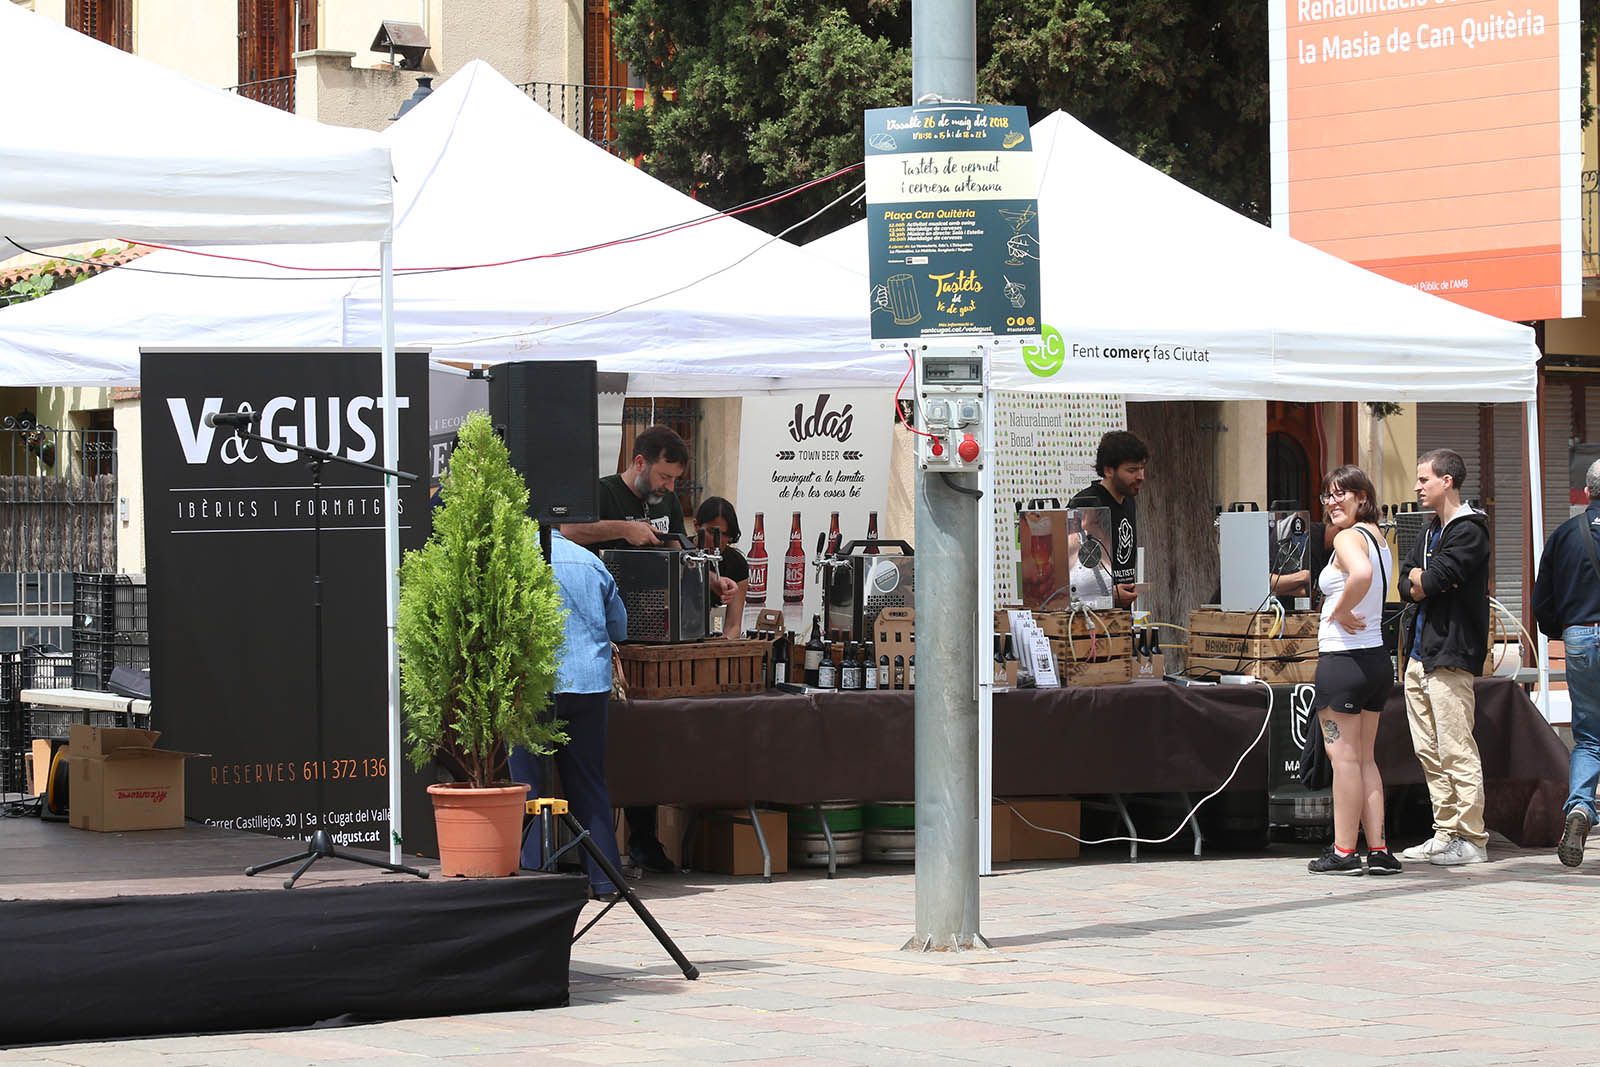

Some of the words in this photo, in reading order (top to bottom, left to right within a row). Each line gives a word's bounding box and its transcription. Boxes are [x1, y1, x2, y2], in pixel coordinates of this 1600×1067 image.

[1298, 39, 1316, 65] la
[1322, 30, 1380, 62] Masia
[1386, 26, 1411, 53] de
[1417, 23, 1454, 49] Can
[1461, 8, 1545, 48] Quitèria
[923, 115, 936, 128] 26
[937, 113, 950, 127] de
[951, 116, 972, 130] maig
[973, 113, 988, 127] del
[989, 116, 1009, 128] 2018
[901, 157, 938, 175] Tastets
[943, 156, 957, 174] de
[961, 155, 1001, 173] vermut
[901, 181, 905, 193] i
[908, 182, 950, 194] cervesa
[954, 175, 1002, 192] artesana
[884, 210, 913, 221] Plaça
[914, 210, 935, 219] Can
[936, 208, 976, 219] Quitèria
[929, 270, 983, 297] Tastets
[1440, 281, 1449, 289] de
[936, 301, 946, 312] Ve
[946, 303, 958, 314] de
[959, 300, 976, 318] gust
[1072, 344, 1100, 359] Fent
[1103, 347, 1150, 362] comerç
[1153, 345, 1170, 360] fas
[1173, 346, 1210, 363] Ciutat
[1009, 412, 1063, 428] Naturalment
[1010, 432, 1034, 448] Bona!
[798, 450, 820, 460] TOWN
[821, 450, 840, 460] BEER
[771, 470, 815, 485] benvingut
[824, 470, 833, 483] la
[779, 485, 790, 498] de
[791, 485, 805, 500] fer
[808, 485, 820, 498] les
[823, 489, 846, 498] coses
[849, 486, 862, 498] bé
[178, 498, 258, 518] IBÈRICS
[273, 501, 278, 516] I
[295, 499, 404, 517] FORMATGS
[210, 762, 296, 785] RESERVES
[303, 761, 327, 781] 611
[332, 759, 357, 779] 372
[362, 758, 387, 777] 136
[236, 814, 283, 831] Castillejos,
[285, 813, 297, 827] 30
[306, 812, 327, 826] Sat
[328, 811, 353, 827] Cugat
[355, 809, 369, 822] del
[371, 808, 391, 821] Vallè
